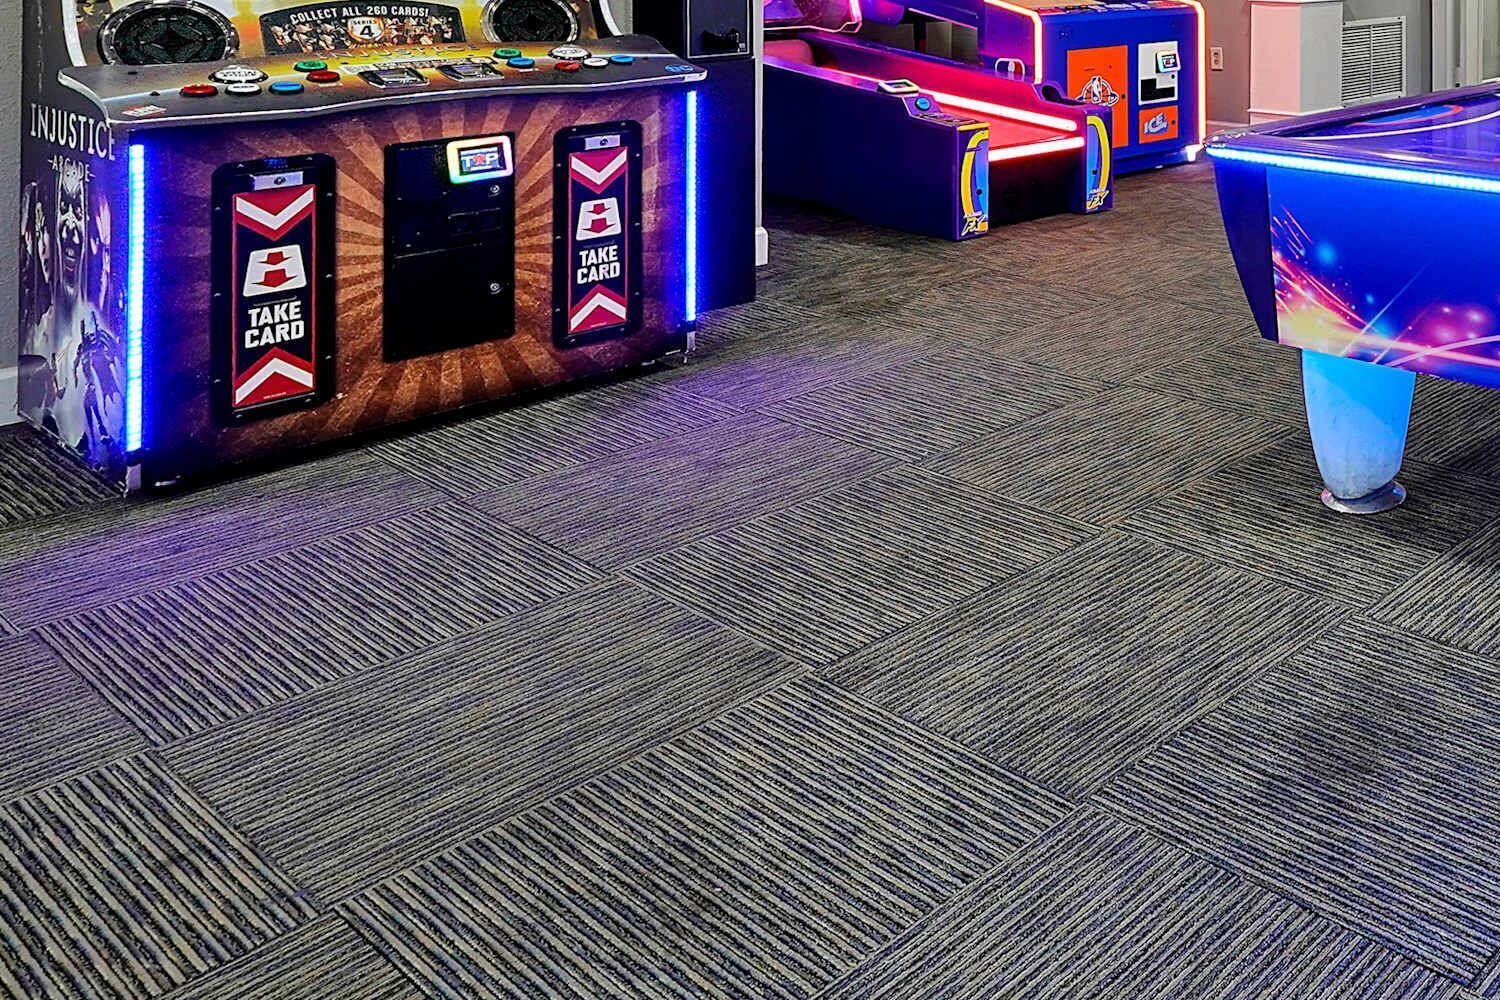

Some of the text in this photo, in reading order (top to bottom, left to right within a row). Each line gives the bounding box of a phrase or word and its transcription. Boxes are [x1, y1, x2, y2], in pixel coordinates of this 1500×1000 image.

[289, 5, 430, 25] COLLECT ALL 260 CARDS!
[359, 25, 375, 37] 4
[30, 103, 115, 161] INJUSTICE
[1143, 112, 1168, 134] ICE
[579, 245, 619, 268] TAKE
[576, 262, 620, 284] CARD
[248, 300, 302, 329] TAKE
[244, 320, 305, 349] CARD
